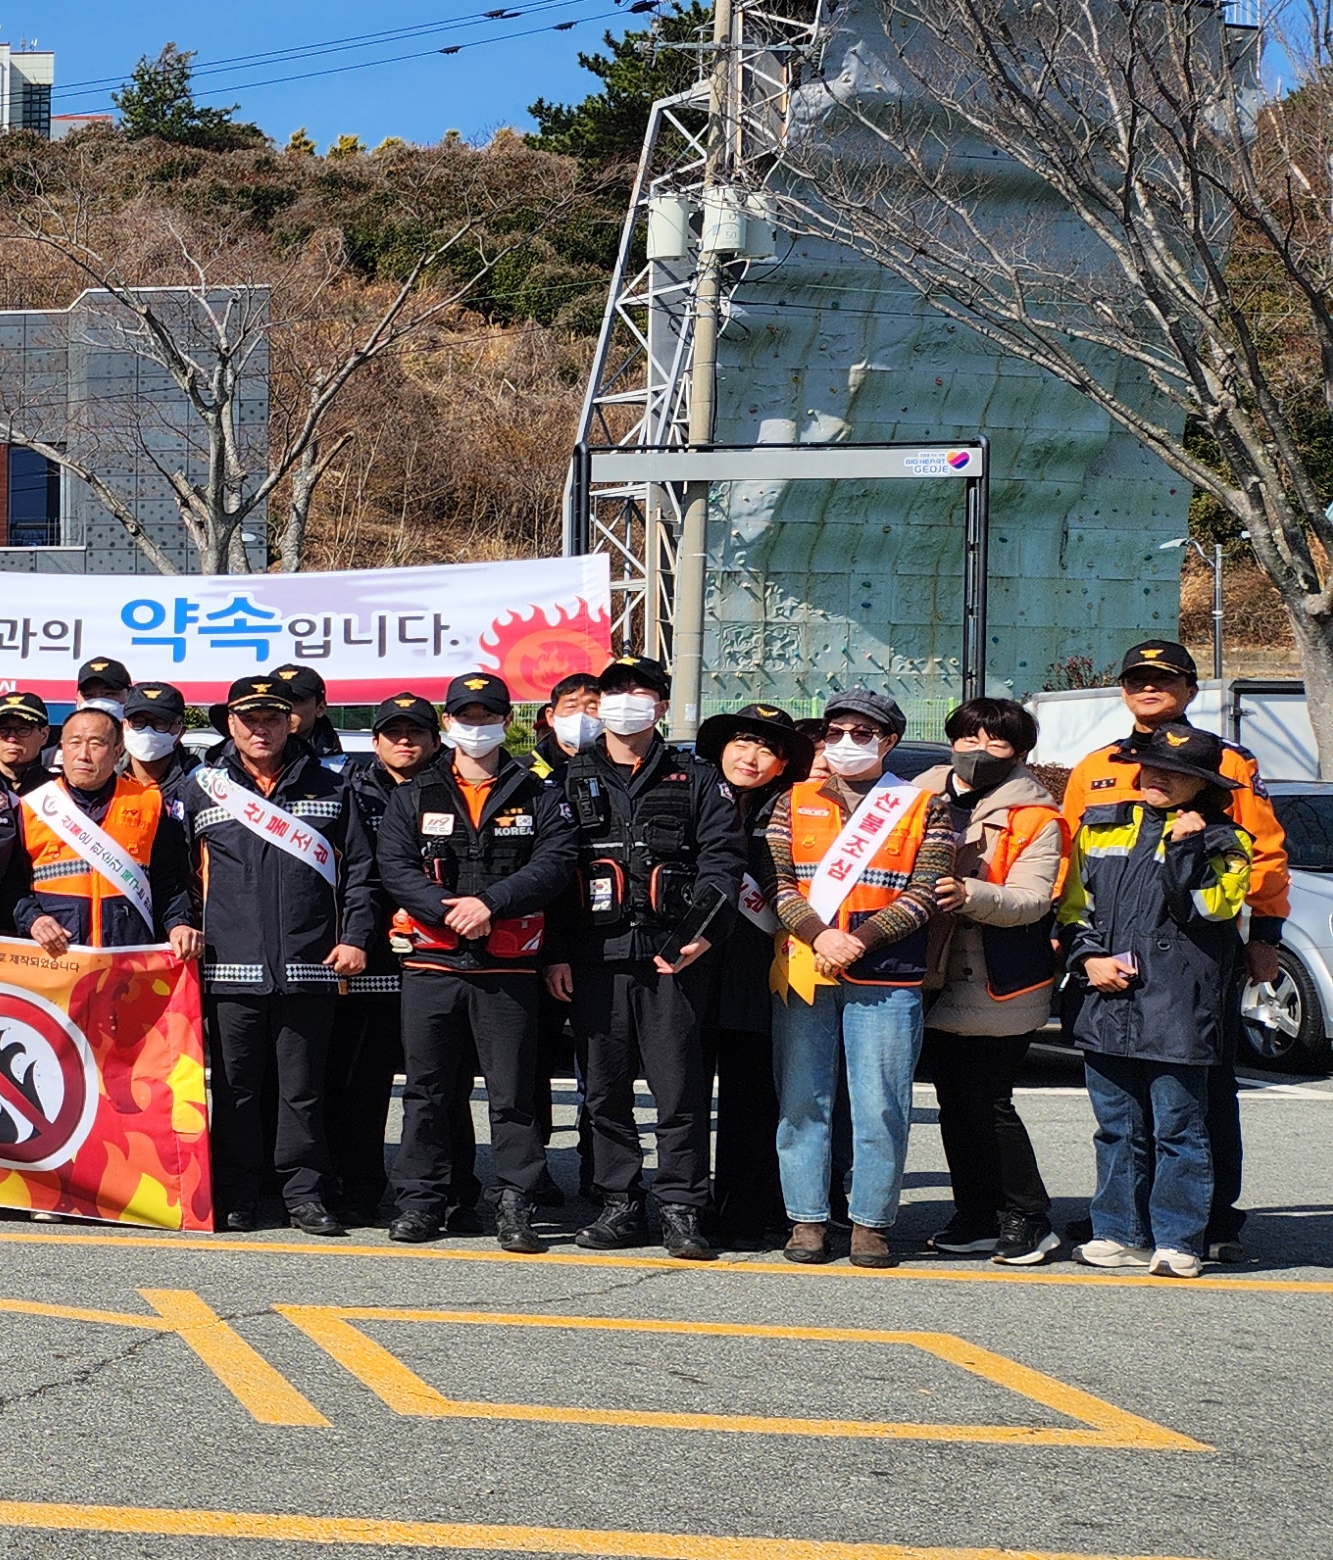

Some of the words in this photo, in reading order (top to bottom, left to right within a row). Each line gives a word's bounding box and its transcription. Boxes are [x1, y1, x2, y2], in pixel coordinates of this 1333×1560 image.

[914, 465, 949, 474] GEOJE
[120, 594, 460, 664] 약속입니다.
[243, 801, 330, 866] 산불조심
[494, 826, 535, 837] KOREA
[825, 790, 902, 882] 산불조심
[9, 953, 80, 974] 제작되었습니다
